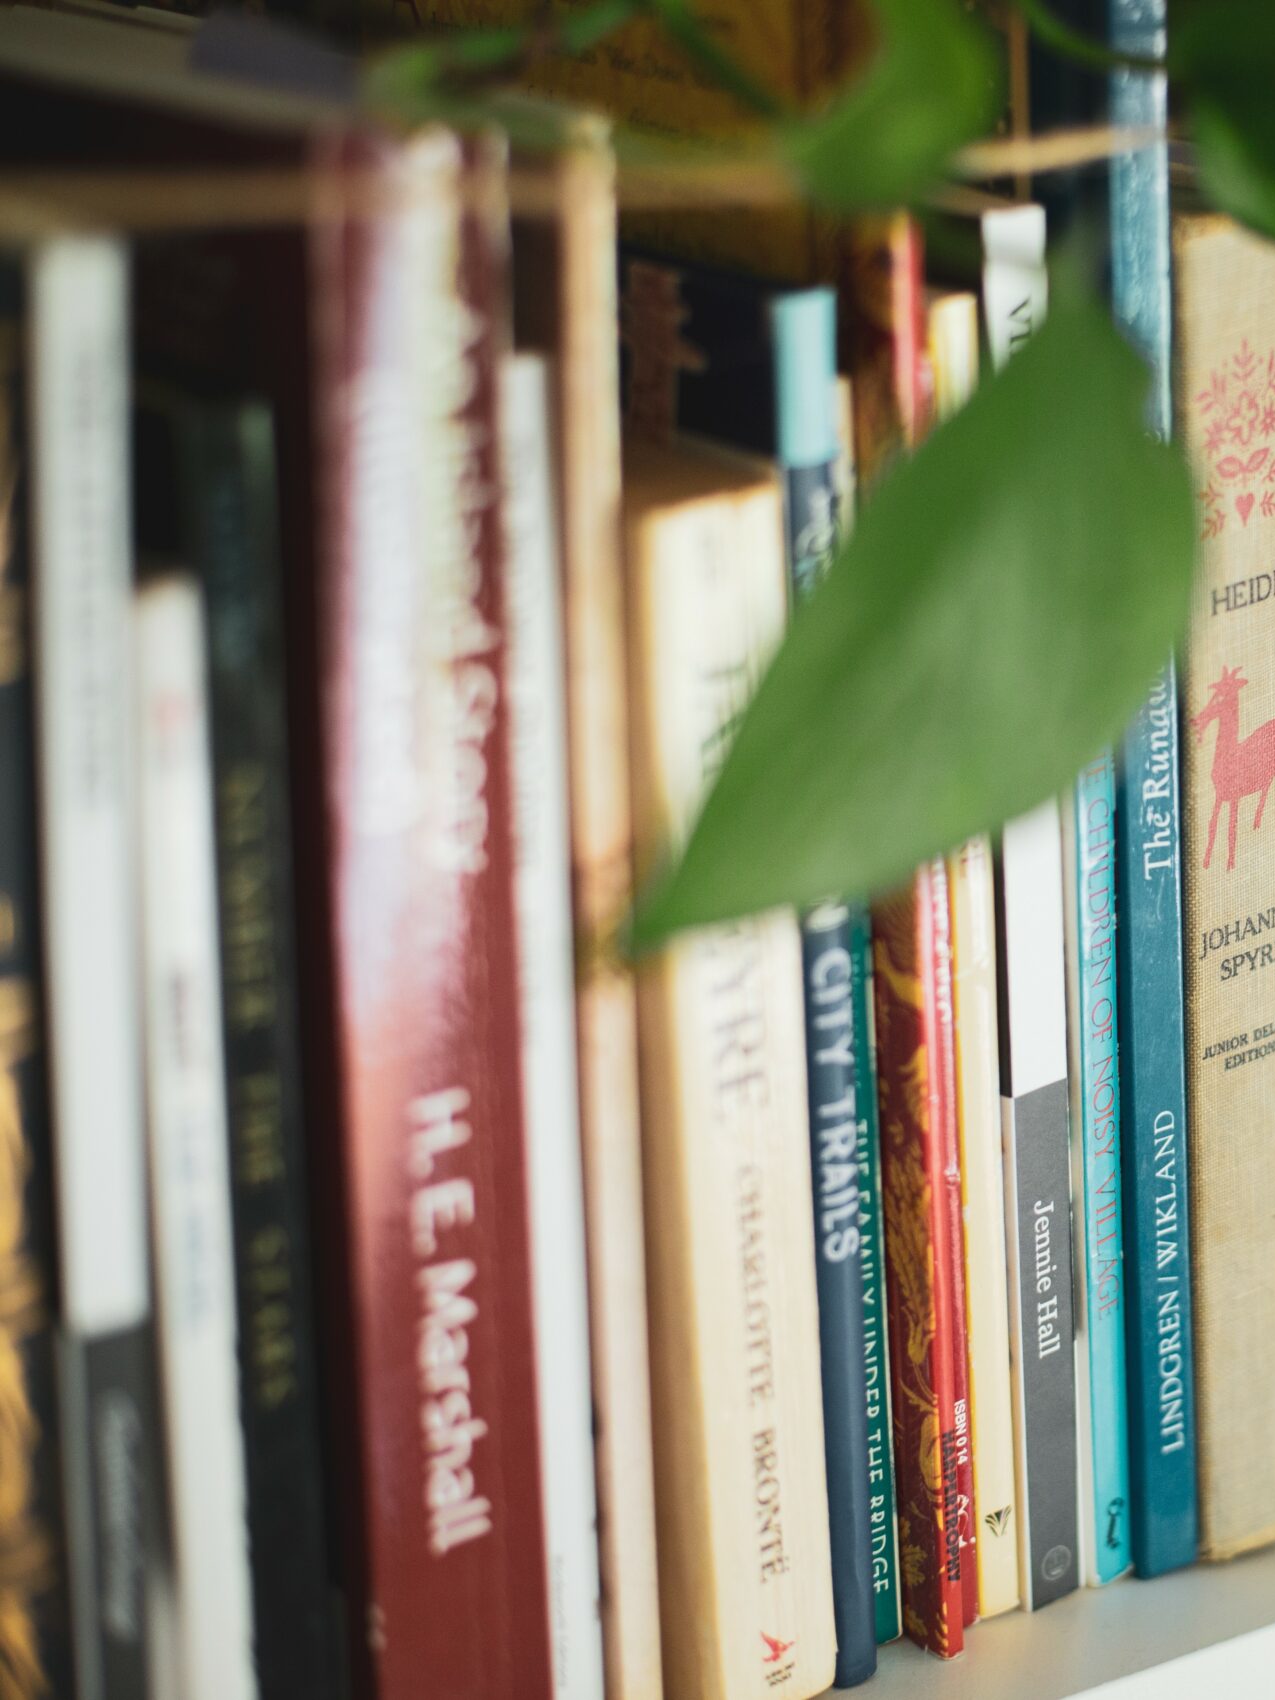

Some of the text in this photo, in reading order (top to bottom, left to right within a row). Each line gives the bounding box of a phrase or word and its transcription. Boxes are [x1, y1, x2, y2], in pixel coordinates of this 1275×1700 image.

[1087, 797, 1114, 986] CHILDREN
[1143, 811, 1172, 880] The
[810, 946, 855, 1066] CITY
[1091, 999, 1115, 1044] OF
[1202, 1032, 1249, 1060] JUNIOR
[817, 1085, 859, 1263] TRAILS
[1092, 1055, 1117, 1158] NOISY
[408, 1176, 475, 1257] E.
[1096, 1168, 1120, 1320] VILLAGE
[1152, 1109, 1178, 1269] WIKLAND
[1033, 1200, 1061, 1360] Jennie Hall
[417, 1257, 494, 1559] Marshall
[735, 1164, 792, 1584] CHARLOTTE BRONTË
[954, 1399, 967, 1435] ISBN
[1158, 1291, 1186, 1455] LINDGREN
[942, 1430, 961, 1581] HARPERTROPHY
[957, 1448, 968, 1465] 14
